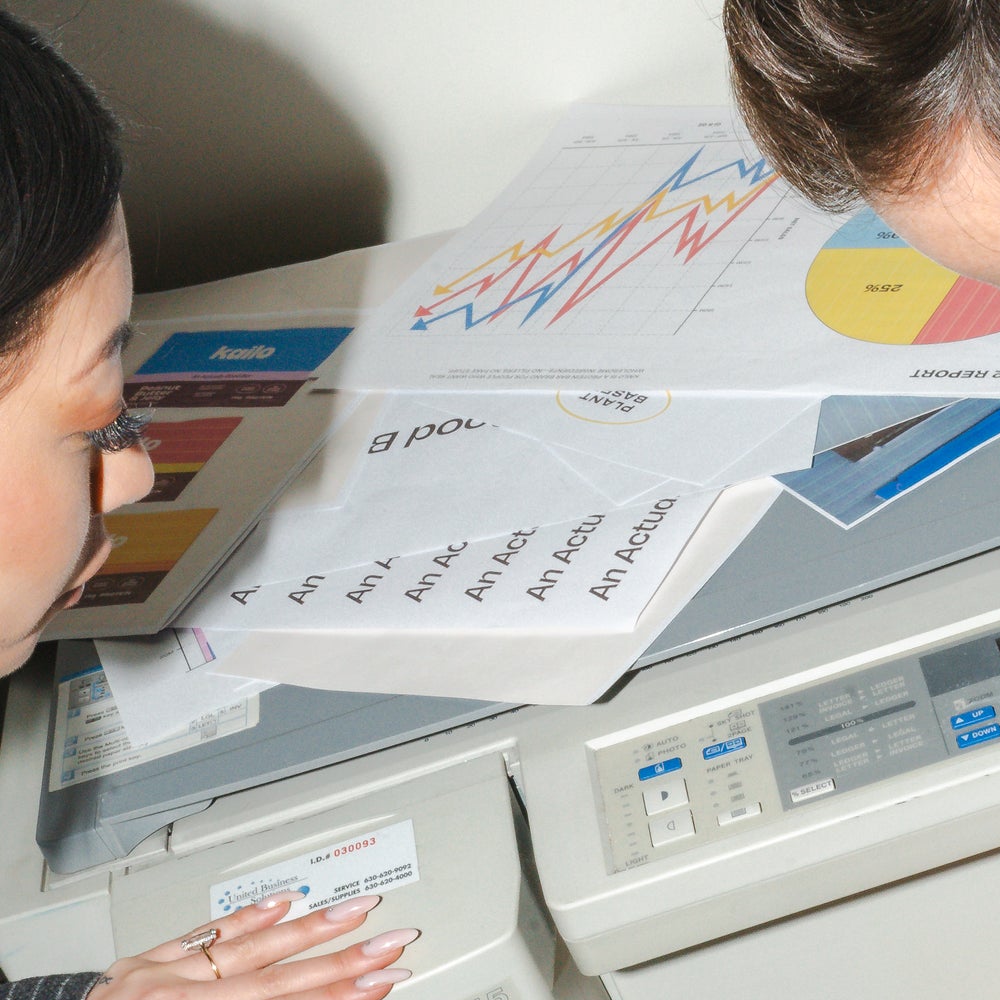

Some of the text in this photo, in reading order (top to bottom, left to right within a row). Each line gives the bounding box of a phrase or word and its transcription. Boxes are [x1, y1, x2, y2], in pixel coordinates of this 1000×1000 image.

[864, 283, 904, 293] 25%
[208, 345, 276, 360] kailo
[909, 368, 989, 379] REPORT
[578, 391, 636, 413] PLANT
[287, 574, 326, 606] An
[345, 575, 384, 605] An
[404, 573, 443, 604] An
[464, 570, 503, 603] An
[526, 567, 564, 602] An
[588, 565, 627, 602] An
[825, 709, 852, 722] LEGAL
[971, 709, 985, 719] UP
[831, 714, 916, 745] LEGAL LETTER
[888, 727, 917, 740] LEGAL
[971, 725, 998, 739] DOWN
[656, 735, 679, 748] AUTO
[657, 743, 687, 757] PHOTO
[706, 754, 755, 774] PAPER TRAY
[613, 783, 635, 794] DARK
[800, 780, 833, 796] SELECT
[333, 837, 377, 858] 030093
[625, 854, 650, 867] LIGHT
[333, 863, 412, 894] SERVICE 630-620-9092
[227, 874, 299, 904] United Business
[308, 870, 413, 911] SALES/SUPPLIES 630-620-4000
